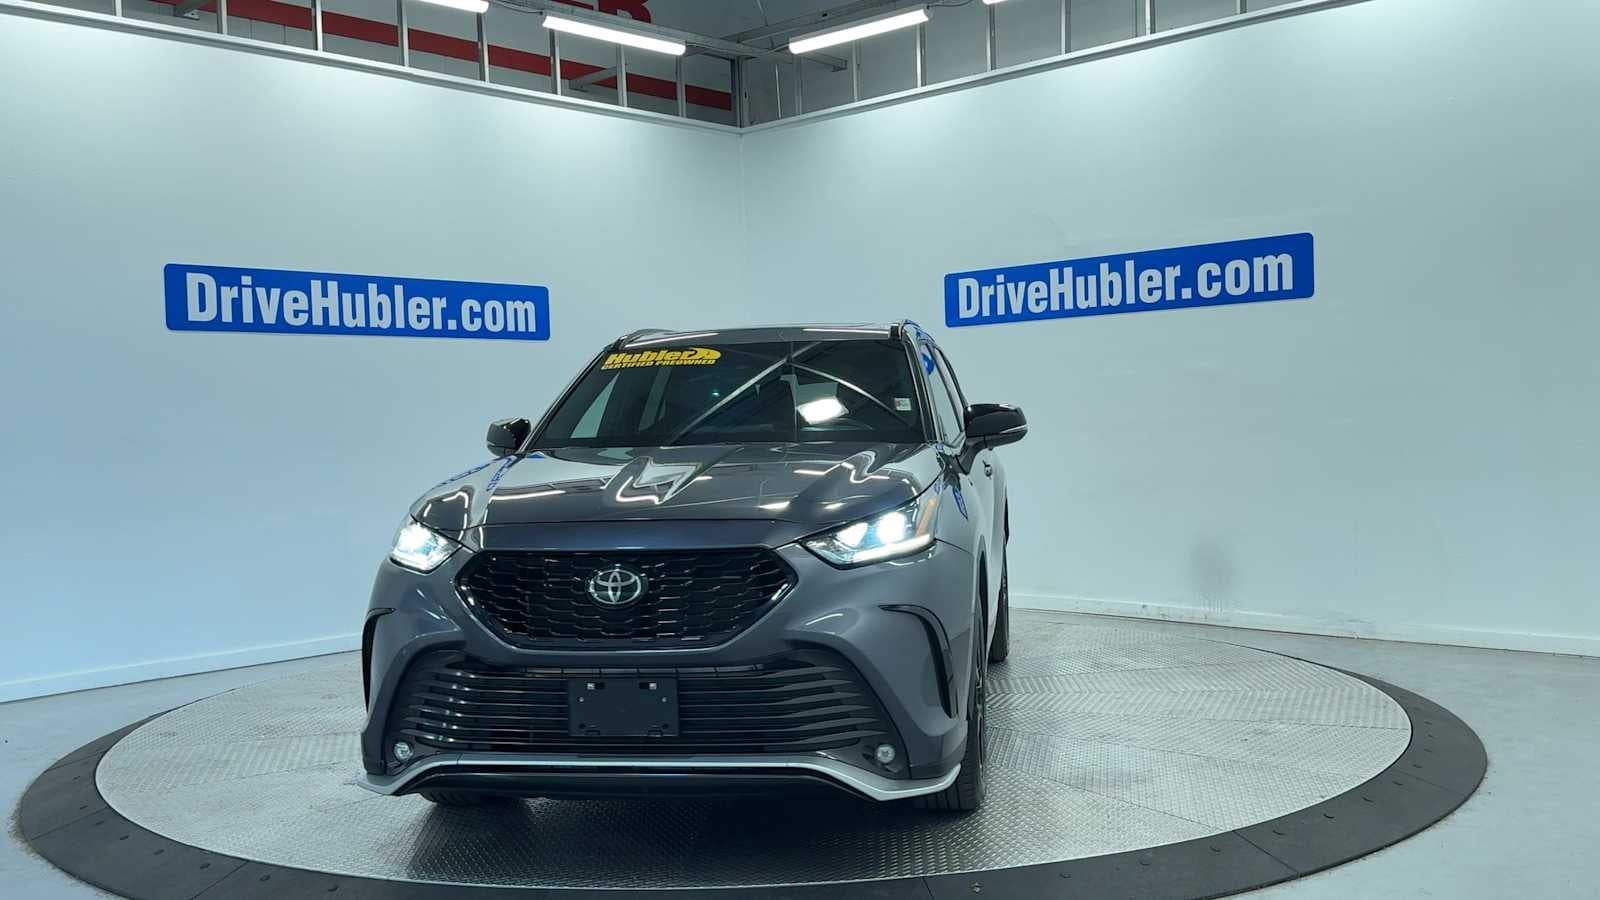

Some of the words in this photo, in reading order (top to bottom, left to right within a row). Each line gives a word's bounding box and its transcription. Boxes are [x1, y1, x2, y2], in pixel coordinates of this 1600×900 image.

[186, 272, 536, 333] DriveHubler.com
[958, 252, 1293, 319] DriveHubler.com
[604, 349, 699, 365] Hubler
